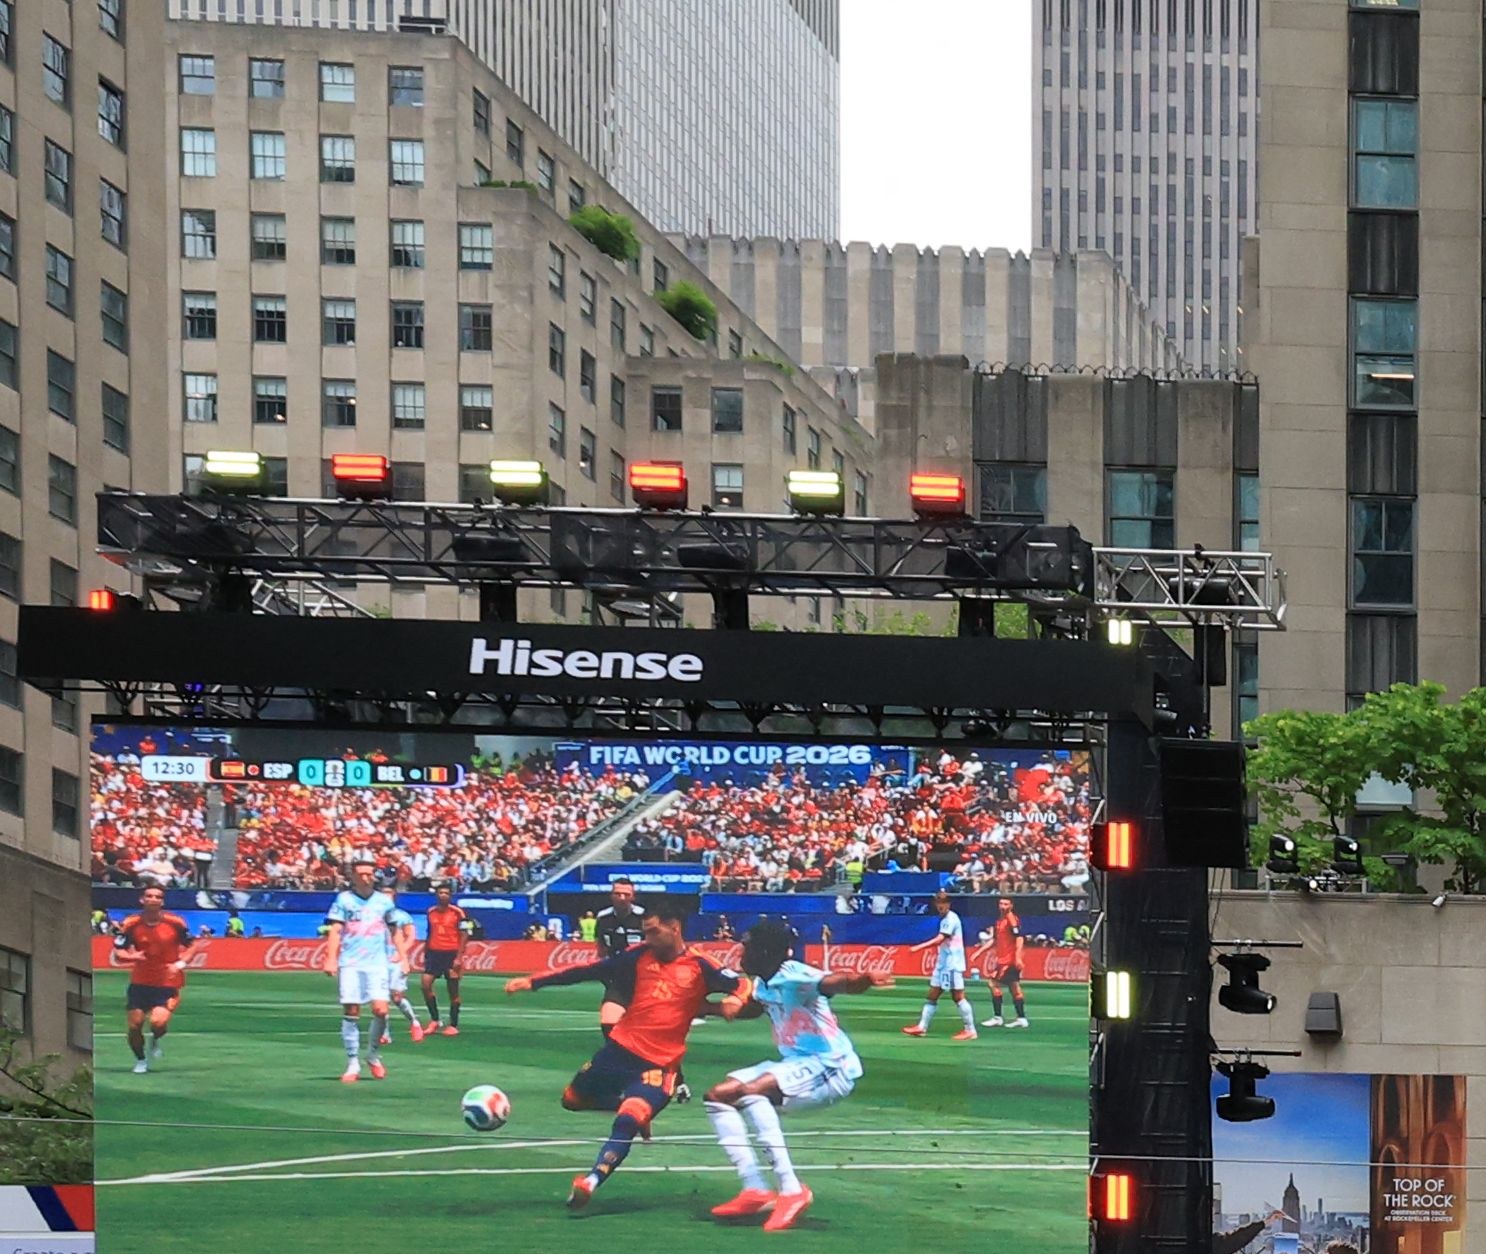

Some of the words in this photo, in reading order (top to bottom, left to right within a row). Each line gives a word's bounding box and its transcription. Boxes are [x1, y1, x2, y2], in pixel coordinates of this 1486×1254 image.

[469, 638, 703, 682] Hisense
[590, 747, 638, 765] FIFA
[733, 746, 782, 765] CUP
[786, 745, 871, 765] 2026
[152, 761, 194, 776] 12:30
[263, 763, 292, 779] ESP
[306, 765, 316, 778] 0
[354, 767, 363, 780] 0
[377, 766, 404, 782] BEL
[1005, 811, 1023, 823] EN
[1027, 812, 1057, 824] VIVO
[1392, 1178, 1422, 1192] TOP
[1424, 1178, 1445, 1192] OF
[1383, 1194, 1408, 1208] THE
[1411, 1194, 1453, 1208] ROCK
